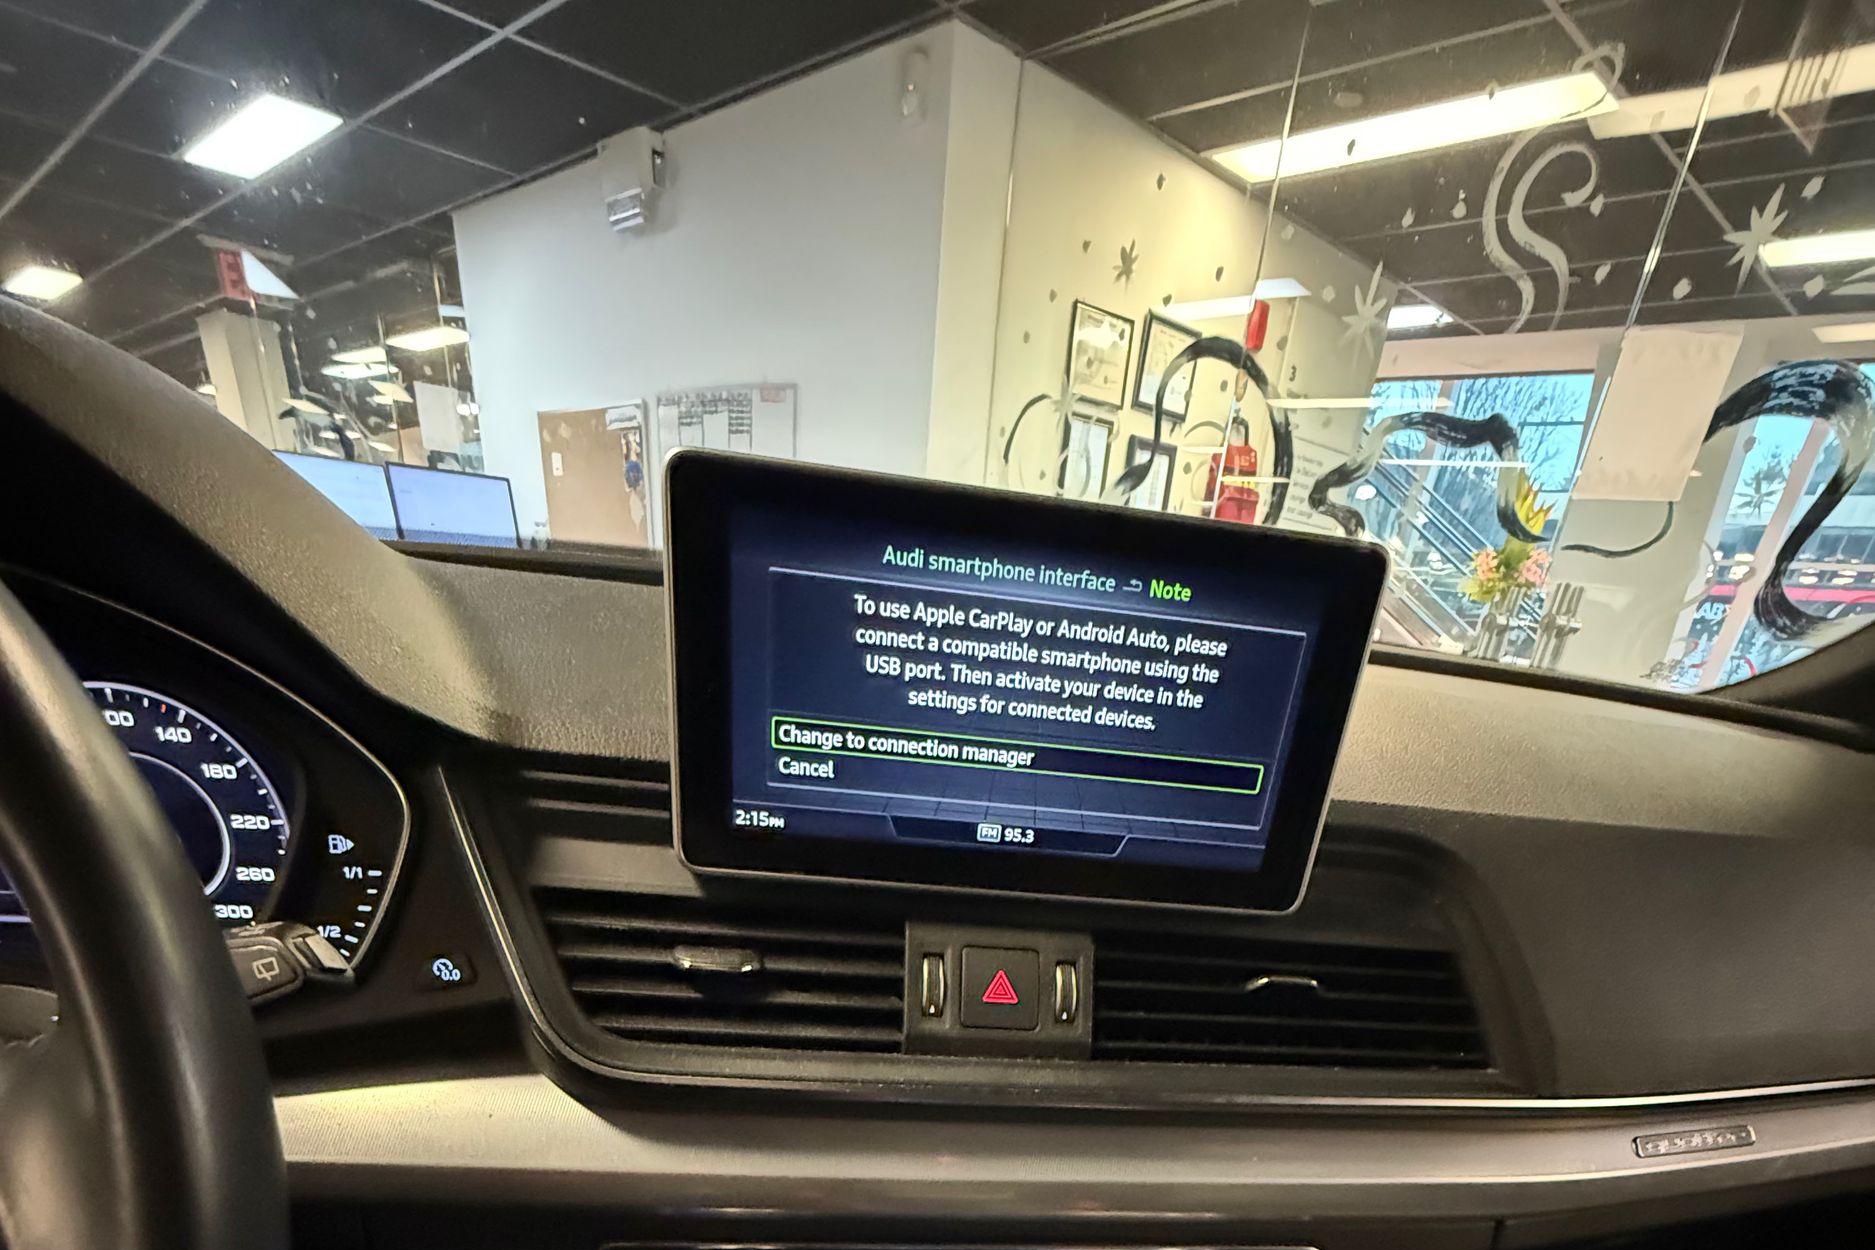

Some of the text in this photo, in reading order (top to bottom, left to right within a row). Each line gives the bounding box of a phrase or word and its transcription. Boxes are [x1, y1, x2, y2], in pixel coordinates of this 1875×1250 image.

[882, 545, 1192, 601] Audi smartphone interface Note
[854, 595, 1228, 657] To use Apple CarPlay or Android Auto, please
[856, 628, 1219, 684] connect a compatible smartphone using the
[865, 654, 1204, 709] USB port. Then activate your device in the
[908, 689, 1156, 730] settings for connected devices.
[154, 726, 192, 743] 140
[778, 724, 1035, 769] Change to connection manager
[200, 763, 238, 780] 180
[777, 756, 835, 779] Cancel
[230, 814, 270, 830] 220
[981, 827, 1035, 844] FM 95.3
[235, 867, 275, 882] 260
[342, 866, 363, 880] 1/1
[214, 905, 253, 919] 300
[317, 925, 341, 938] 1/2
